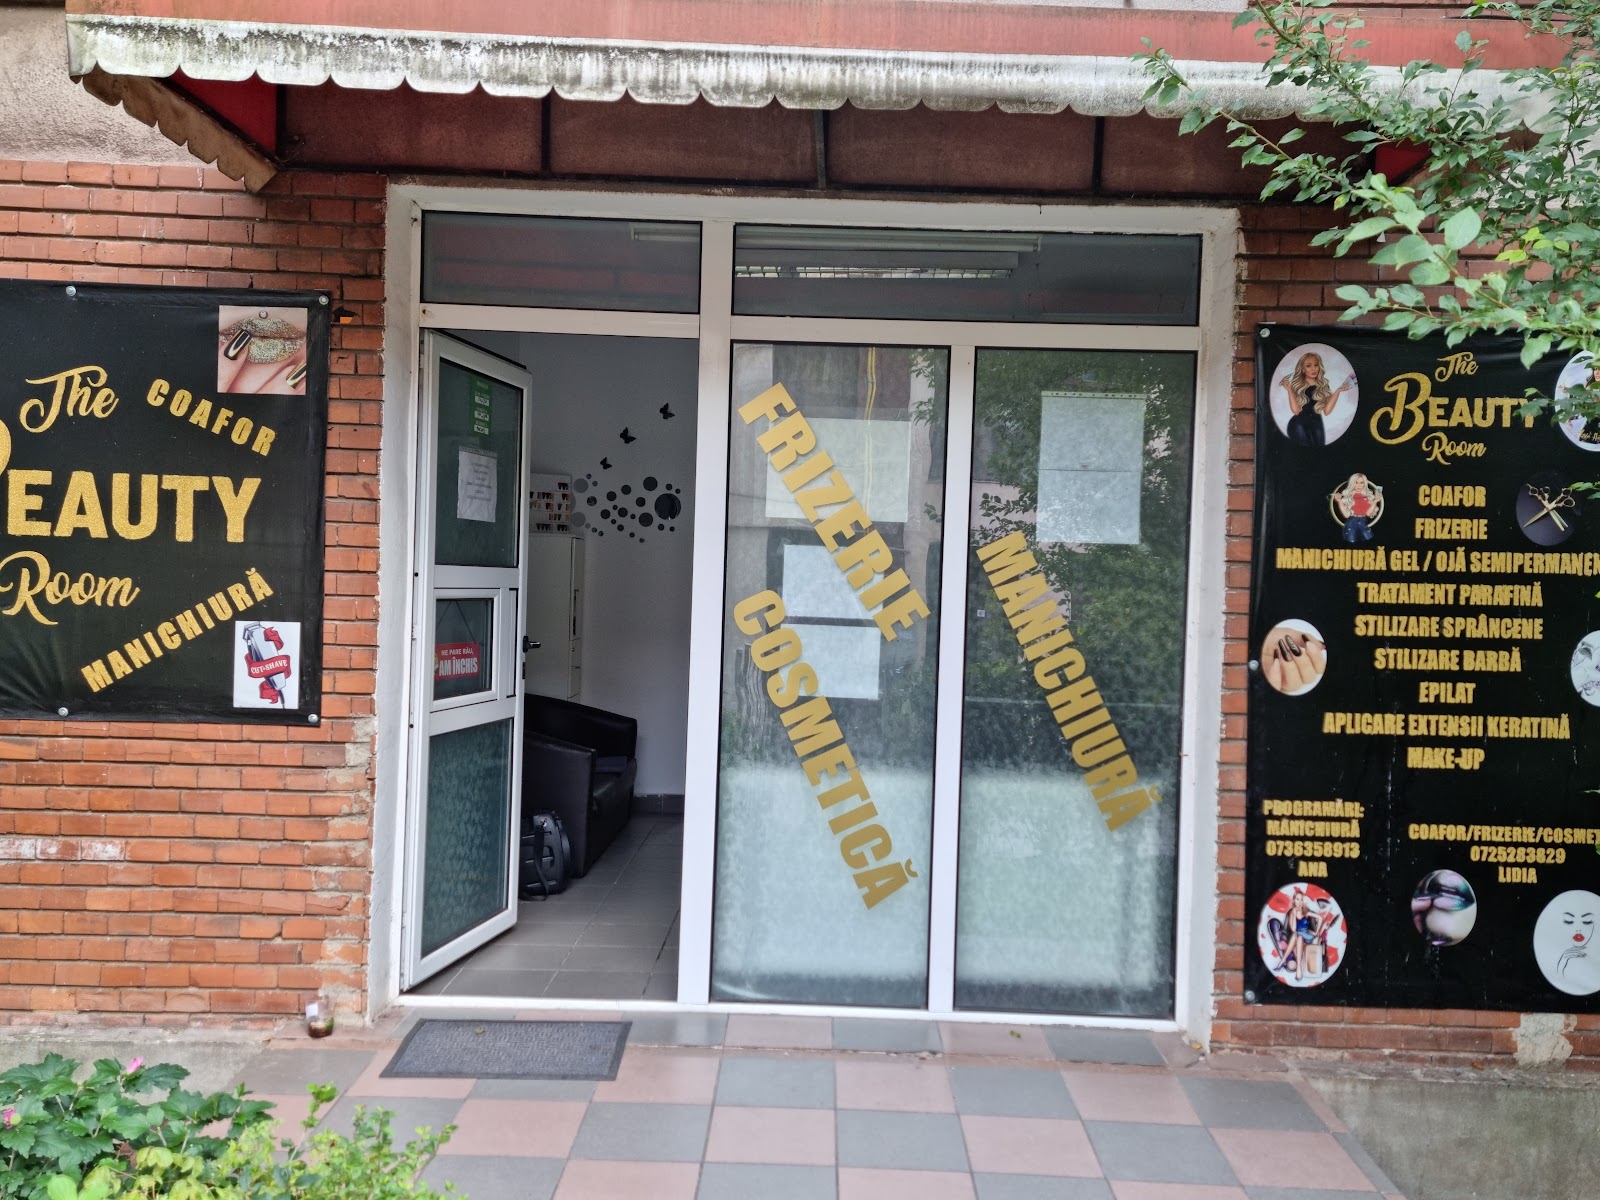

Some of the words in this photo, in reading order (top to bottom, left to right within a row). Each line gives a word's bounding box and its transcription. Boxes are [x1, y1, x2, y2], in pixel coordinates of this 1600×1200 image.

[1434, 351, 1479, 382] The
[20, 365, 119, 433] The
[146, 378, 278, 457] COAFOR
[1422, 432, 1487, 465] Room
[0, 419, 261, 543] EAUTY
[1418, 484, 1487, 508] COAFOR
[738, 382, 930, 642] FRIZERIE
[1415, 517, 1488, 540] FRIZERIE
[1276, 546, 1387, 571] MANICHIURĂ
[1390, 549, 1420, 572] GEL
[1422, 550, 1432, 572] /
[1435, 547, 1467, 572] OJĂ
[0, 551, 140, 625] Room
[1357, 582, 1456, 605] TRATAMENT
[1459, 582, 1543, 607] PARAFINĂ
[80, 567, 274, 692] MANICHIURĂ
[1355, 614, 1440, 638] STILIZARE
[1443, 614, 1543, 640] SPRÂNCENE
[439, 660, 451, 676] AM
[452, 656, 478, 675] ÎNCHIS
[1374, 648, 1459, 670] STILIZARE
[1463, 647, 1522, 672] BARBĂ
[977, 531, 1162, 832] MANICHIURĂ
[1419, 682, 1476, 704] EPILAT
[1323, 712, 1405, 735] APLICARE
[1408, 714, 1483, 737] EXTENSII
[1487, 714, 1570, 739] KERATINĂ
[733, 590, 918, 910] COSMETICĂ
[1407, 746, 1486, 770] MAKE-UP
[1266, 840, 1360, 858] 0736358913
[1298, 860, 1328, 878] ANA
[1498, 866, 1537, 883] LIDIA
